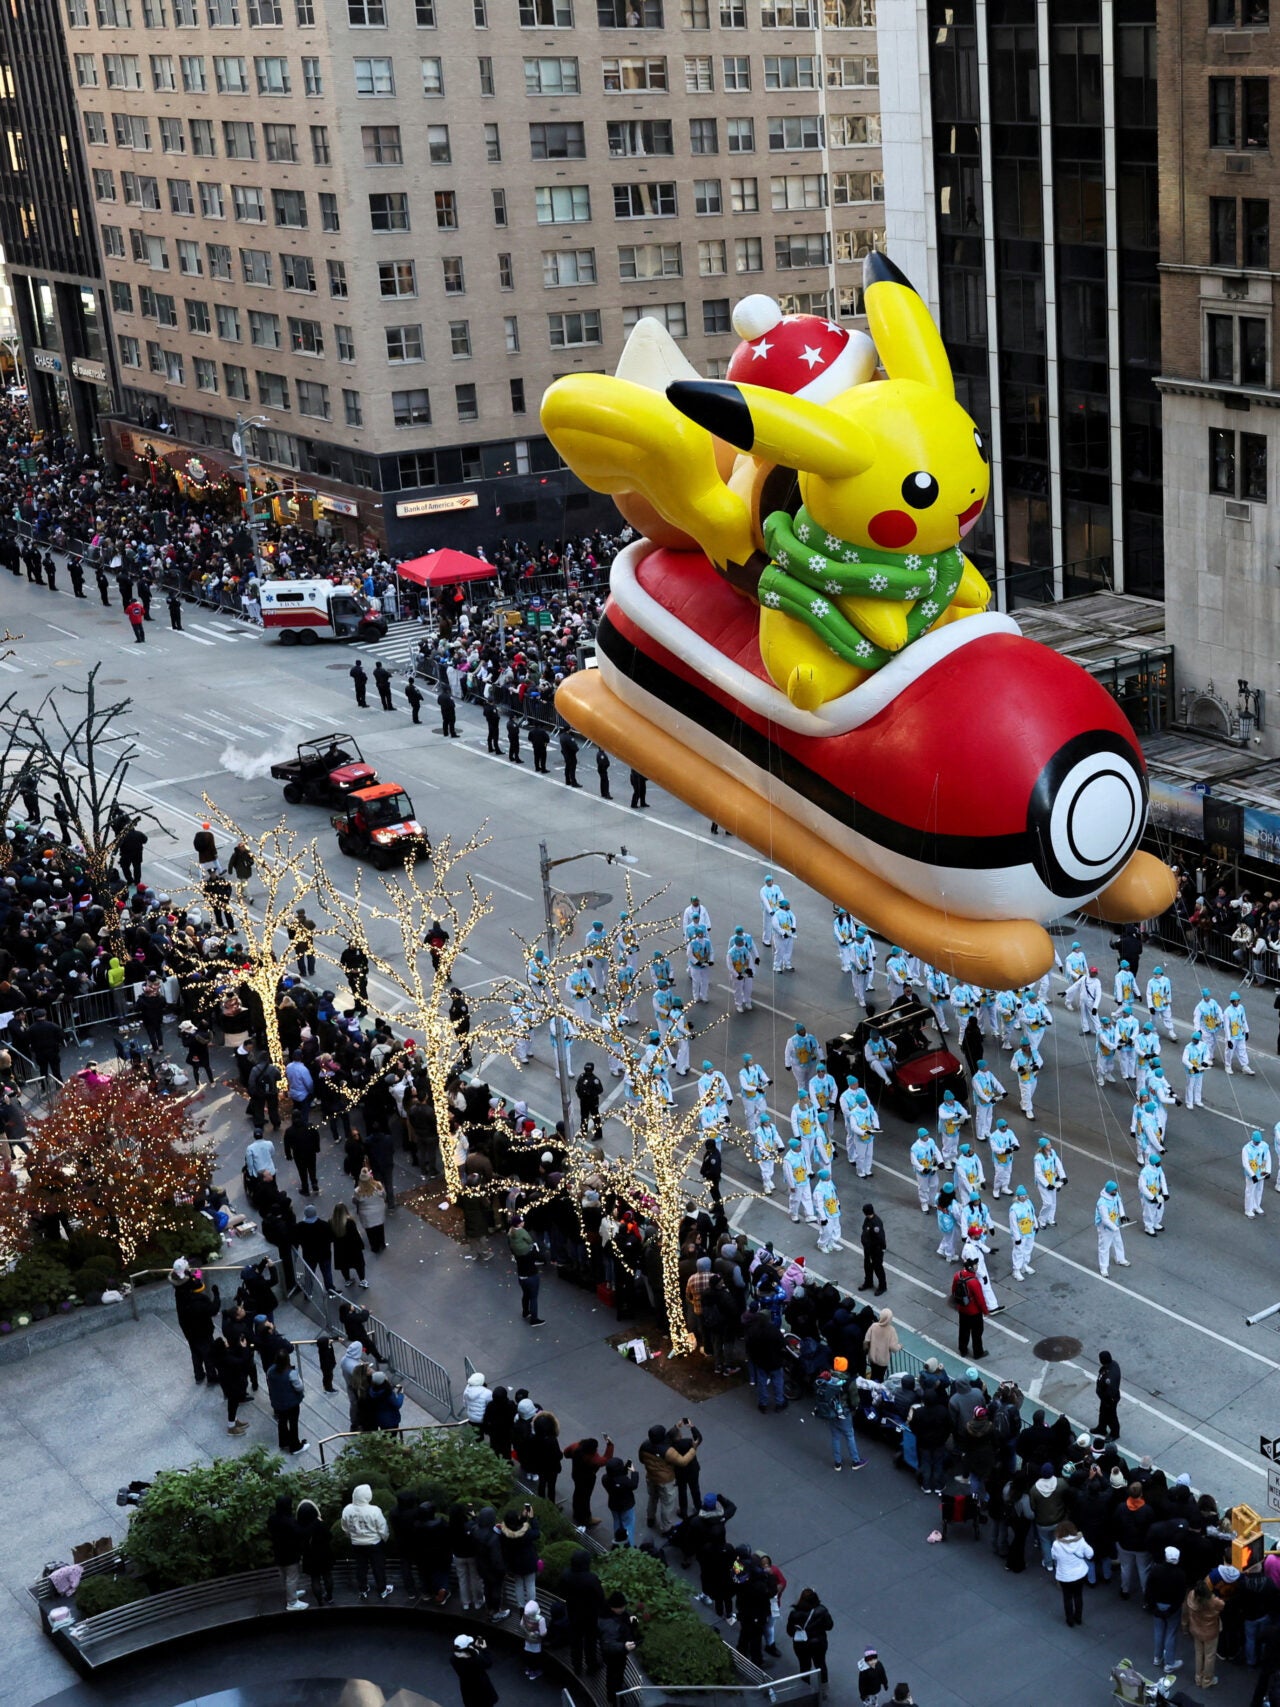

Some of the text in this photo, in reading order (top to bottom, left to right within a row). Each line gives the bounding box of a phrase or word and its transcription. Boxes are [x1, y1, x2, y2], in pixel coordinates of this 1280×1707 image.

[34, 354, 54, 368] CHASE
[428, 501, 454, 510] America
[1253, 829, 1280, 847] DOHA
